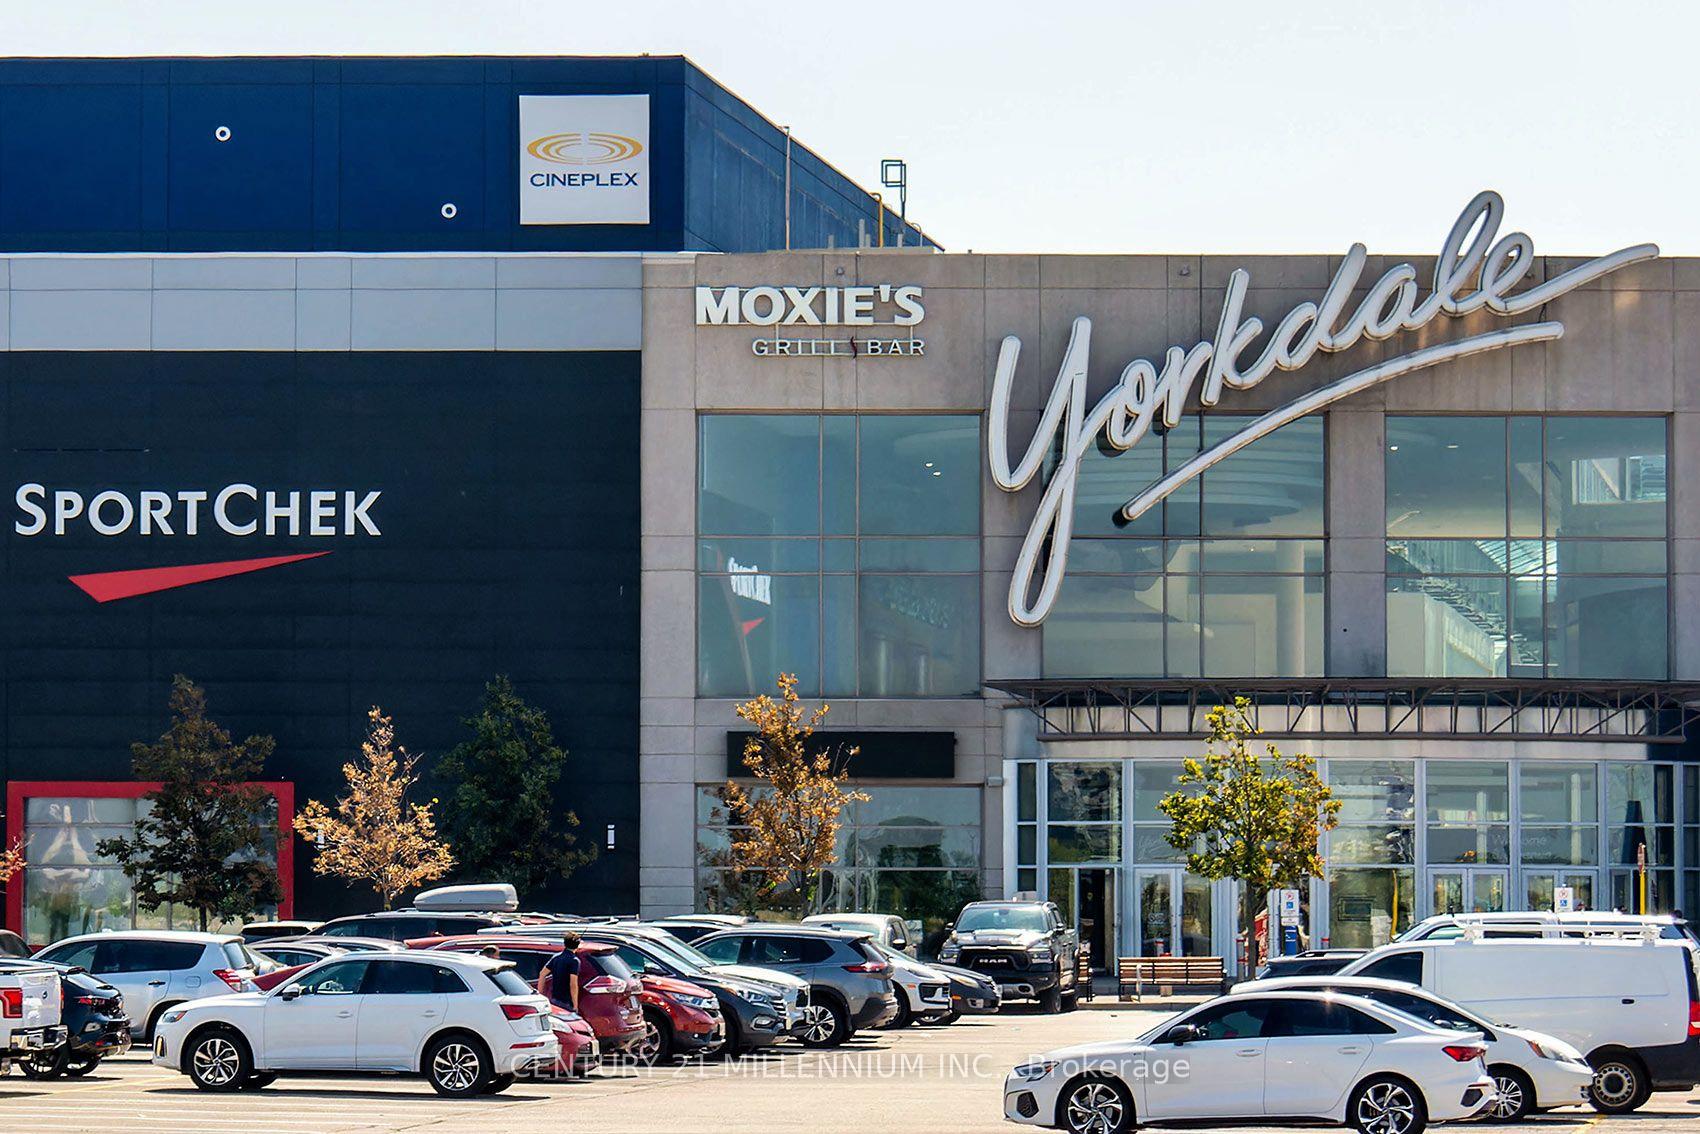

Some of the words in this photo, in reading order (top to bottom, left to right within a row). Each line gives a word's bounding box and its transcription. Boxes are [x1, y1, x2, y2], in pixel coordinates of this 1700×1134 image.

[529, 172, 638, 188] CINEPLEX
[695, 284, 926, 326] MOXIE'S
[752, 338, 837, 356] GRILL
[866, 338, 926, 356] BAR
[987, 190, 1660, 627] Yorkdale
